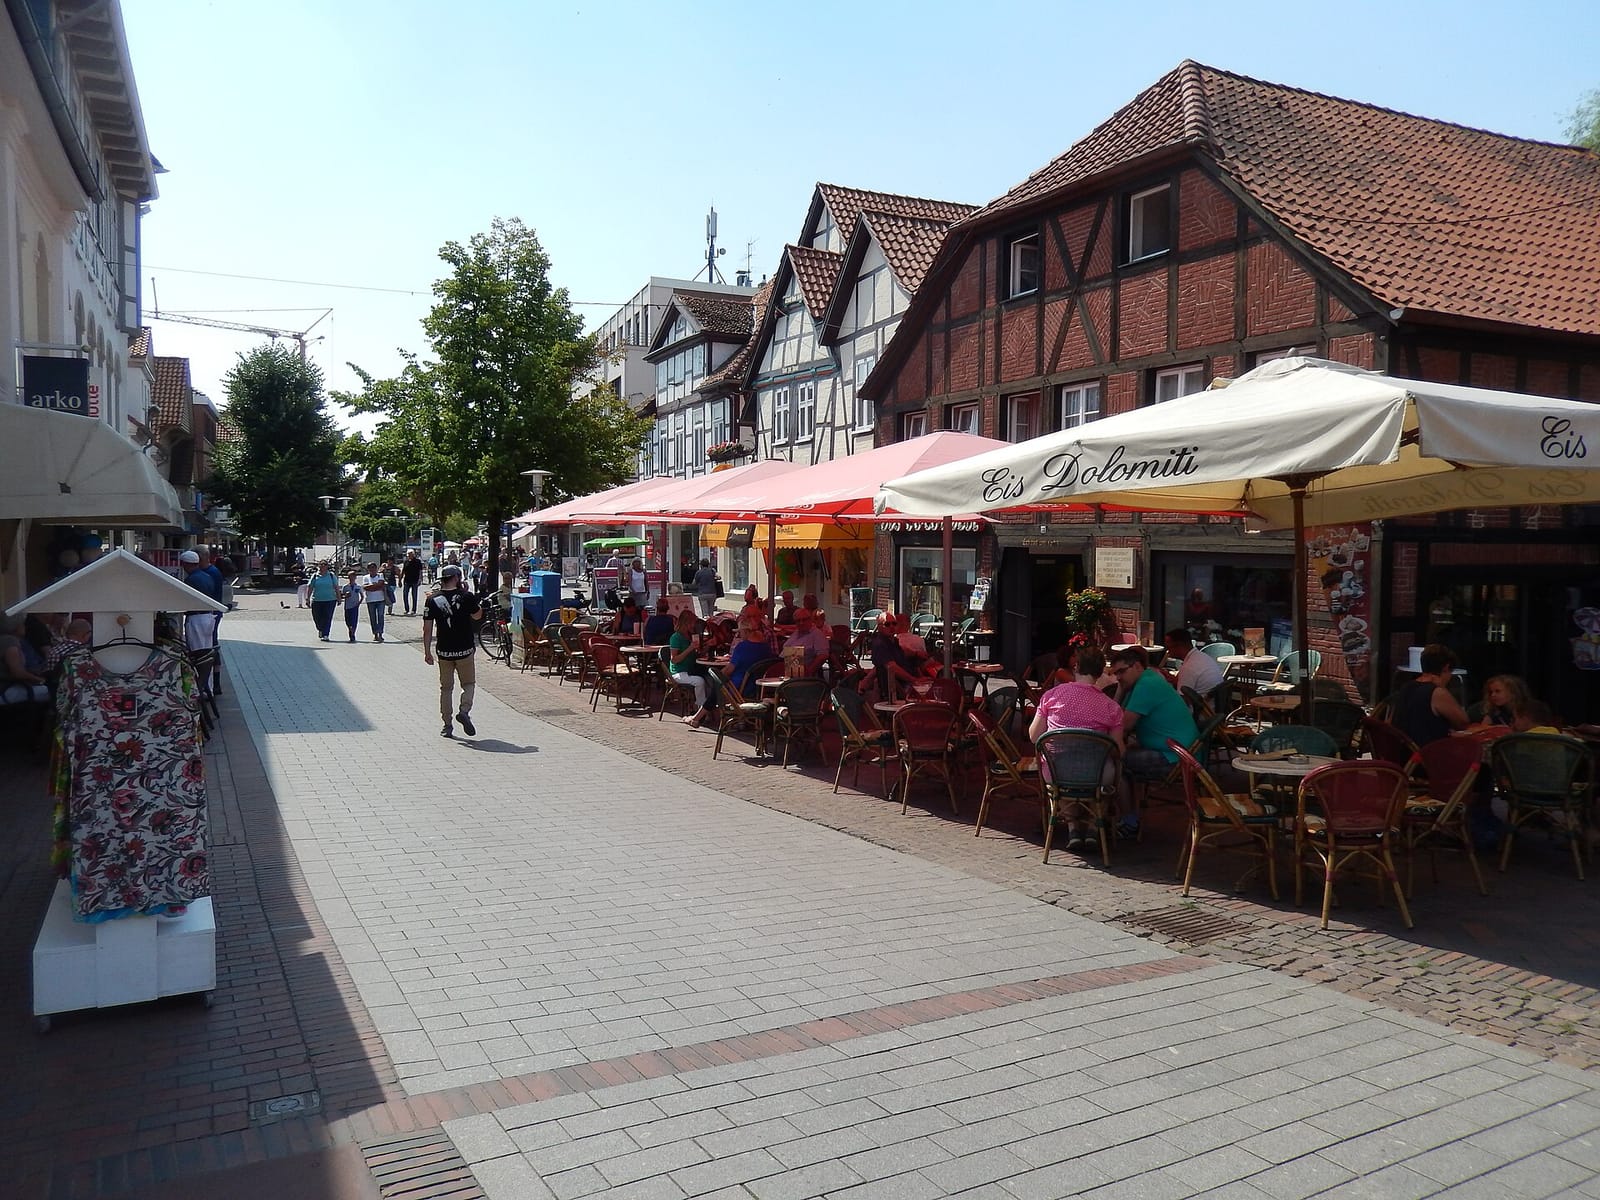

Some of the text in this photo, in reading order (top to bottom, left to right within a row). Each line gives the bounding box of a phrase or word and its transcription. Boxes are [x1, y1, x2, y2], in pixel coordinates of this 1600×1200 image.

[31, 390, 82, 409] arko
[1541, 416, 1587, 459] Eis
[981, 445, 1199, 503] Eis Dolomiti
